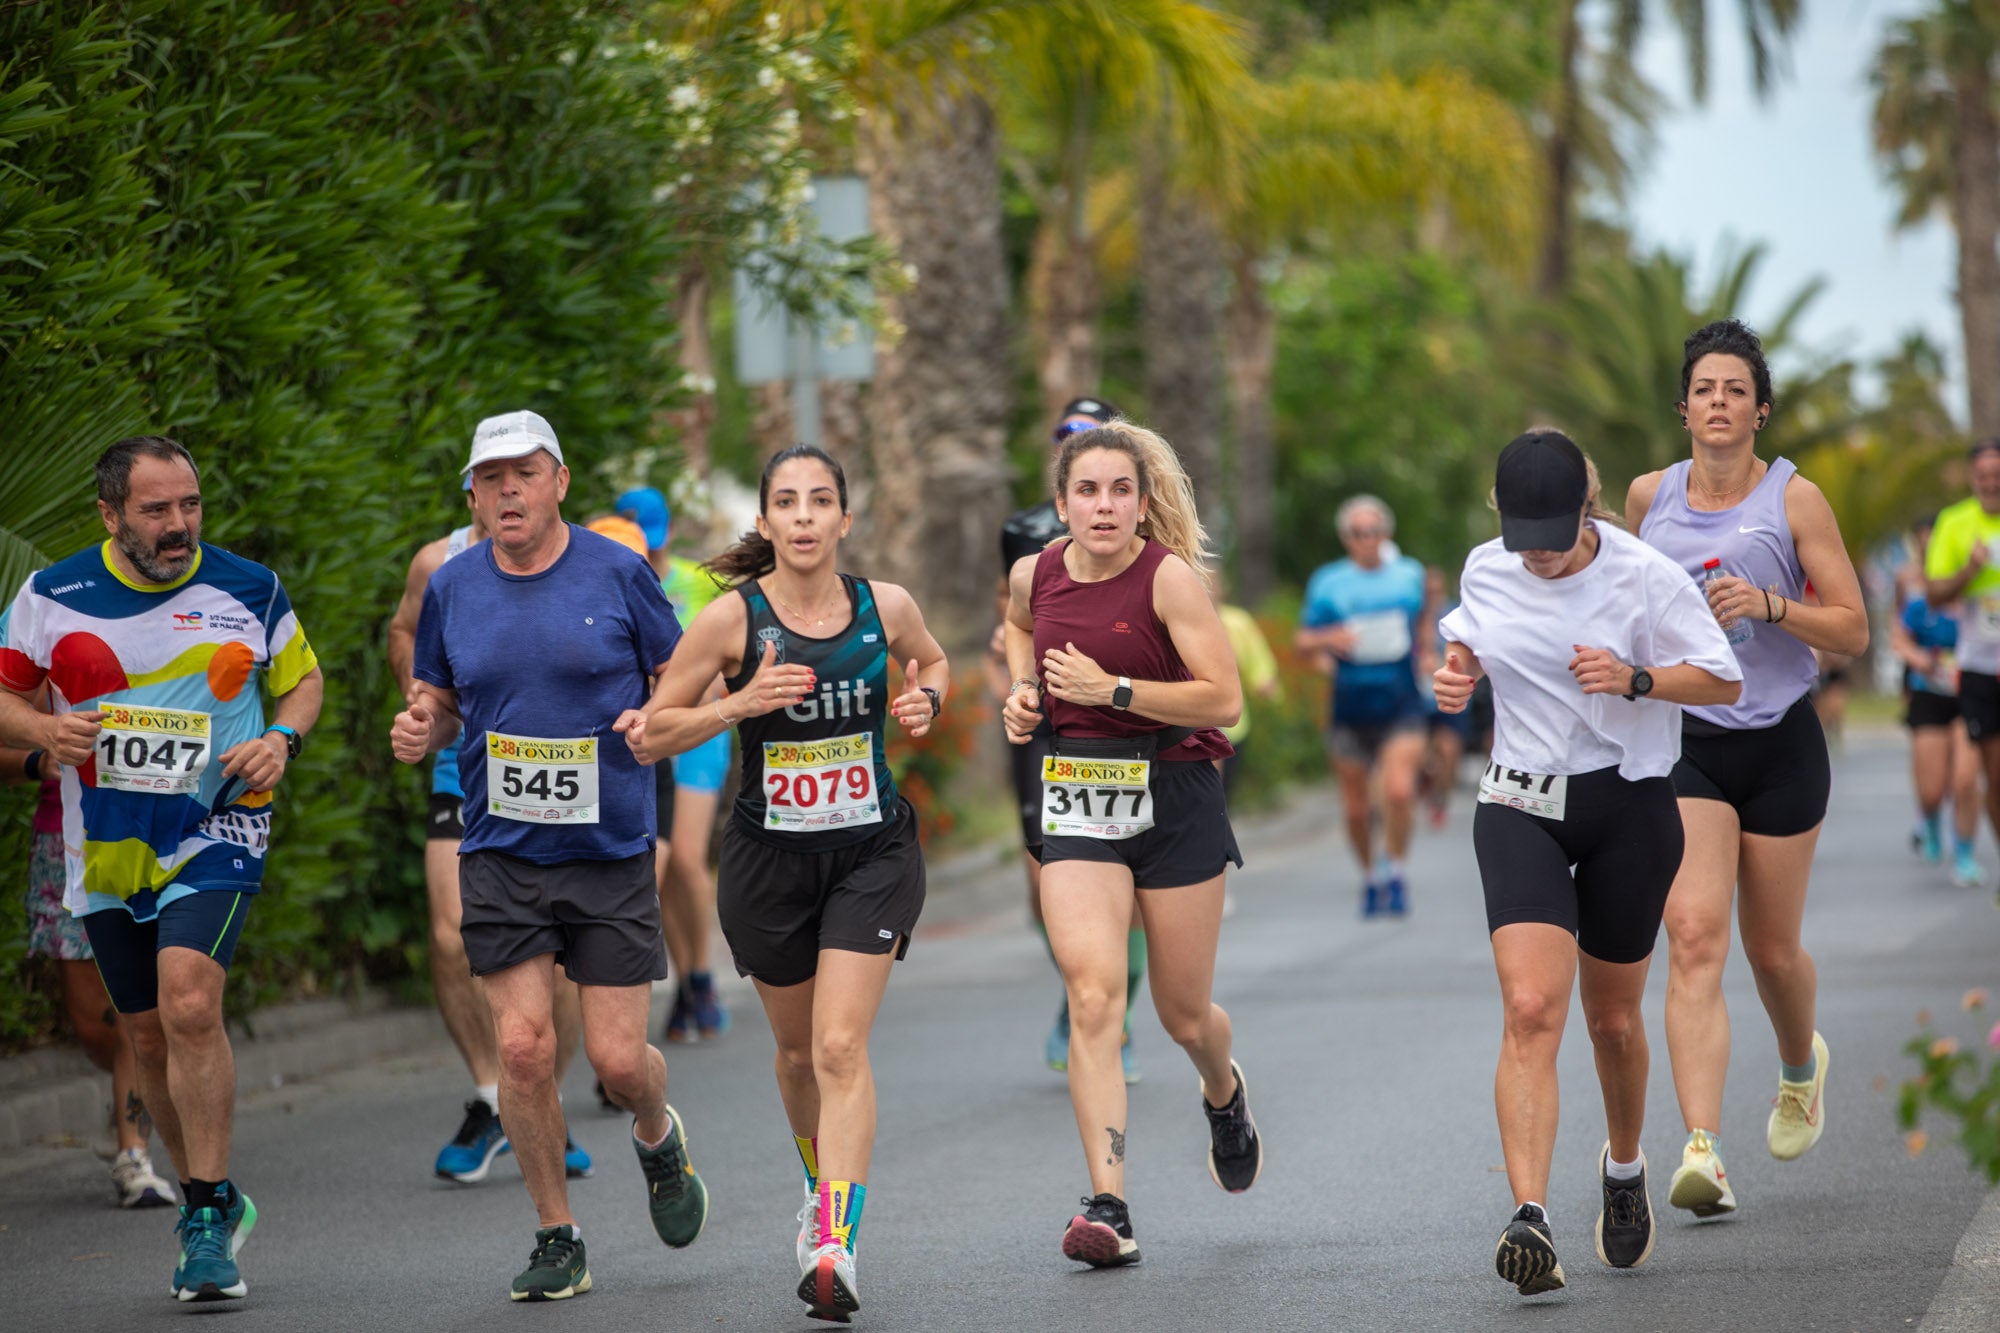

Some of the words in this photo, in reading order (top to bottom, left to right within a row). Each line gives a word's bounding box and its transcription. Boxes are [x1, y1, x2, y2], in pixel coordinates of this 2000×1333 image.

[784, 678, 871, 722] Giit
[113, 709, 129, 724] 38
[155, 712, 184, 720] PREMIO
[129, 715, 188, 730] FONDO
[100, 734, 205, 771] 1047
[500, 740, 516, 756] 38
[519, 741, 540, 749] GRAN
[516, 746, 574, 760] FONDO
[780, 747, 798, 761] 38
[796, 746, 849, 763] FONDO
[1056, 762, 1073, 777] 38
[1072, 767, 1125, 780] FONDO
[502, 765, 580, 801] 545
[767, 765, 870, 808] 2079
[1047, 786, 1146, 818] 3177
